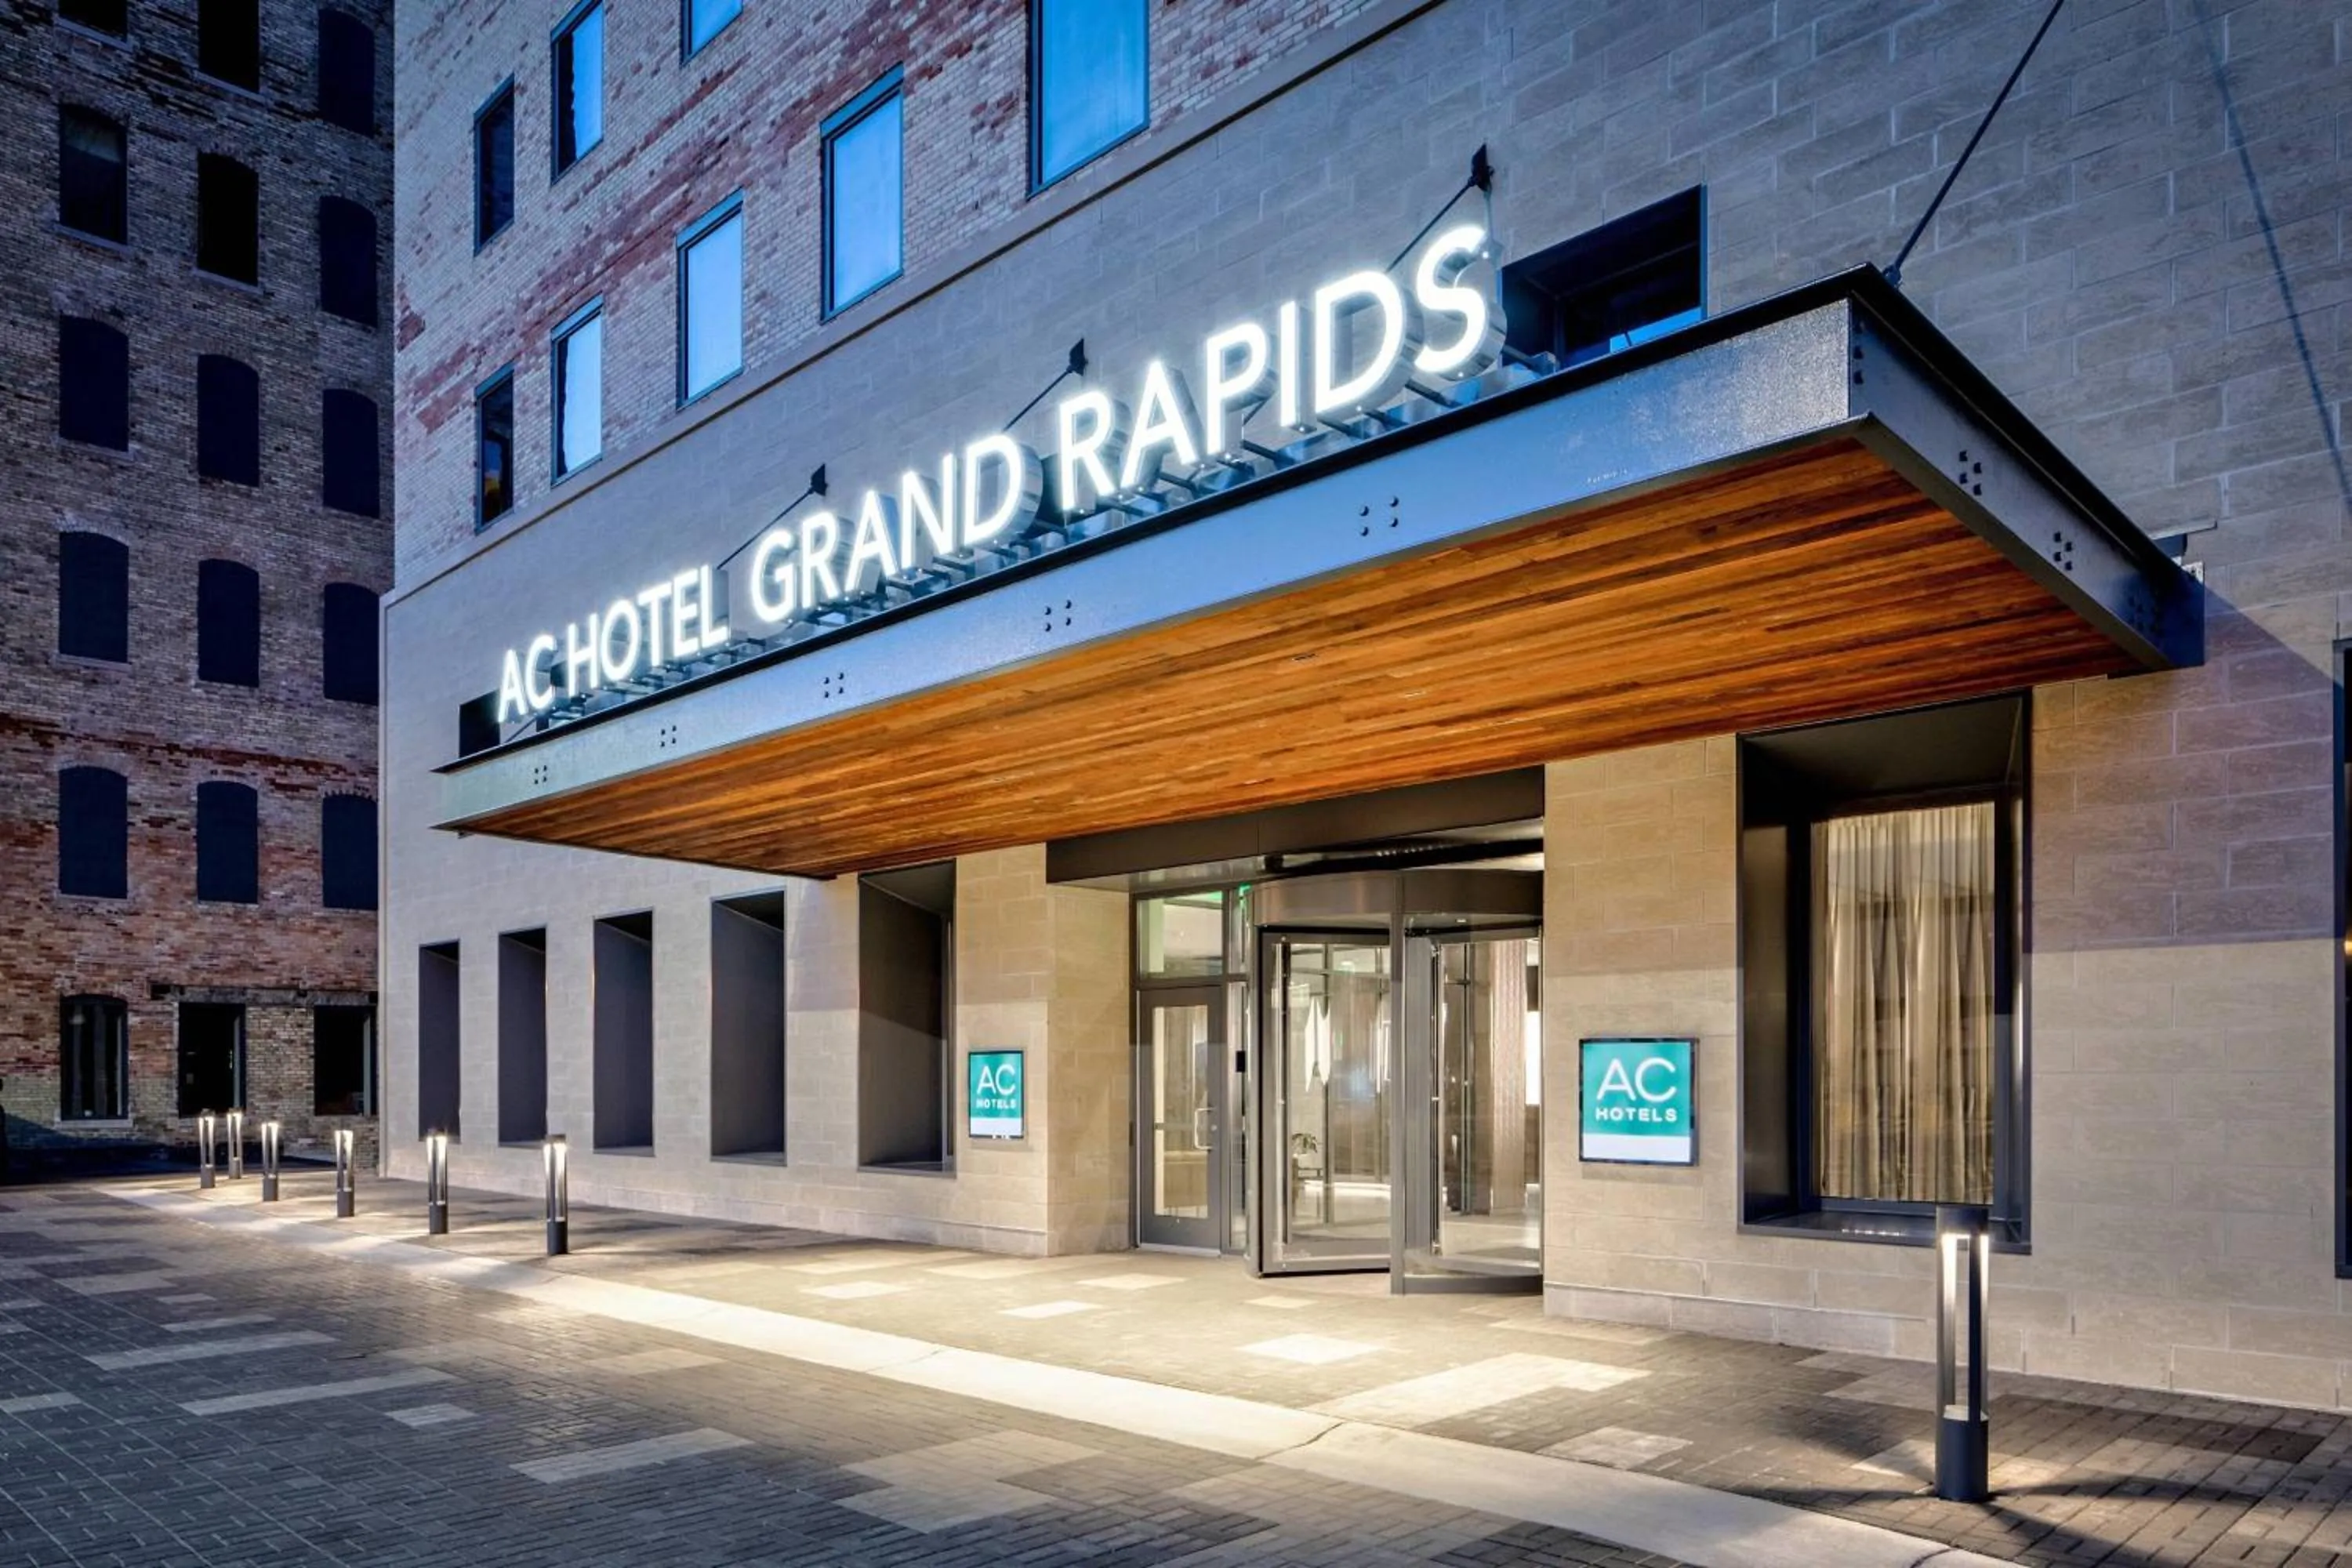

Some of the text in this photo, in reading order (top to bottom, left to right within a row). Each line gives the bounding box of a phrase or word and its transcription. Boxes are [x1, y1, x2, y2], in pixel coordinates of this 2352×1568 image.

[497, 225, 1488, 722] AC HOTEL GRAND RAPIDS
[976, 1063, 1016, 1096] AC
[1596, 1057, 1677, 1103] AC
[975, 1098, 1017, 1109] HOTELS
[1595, 1107, 1679, 1123] HOTELS
